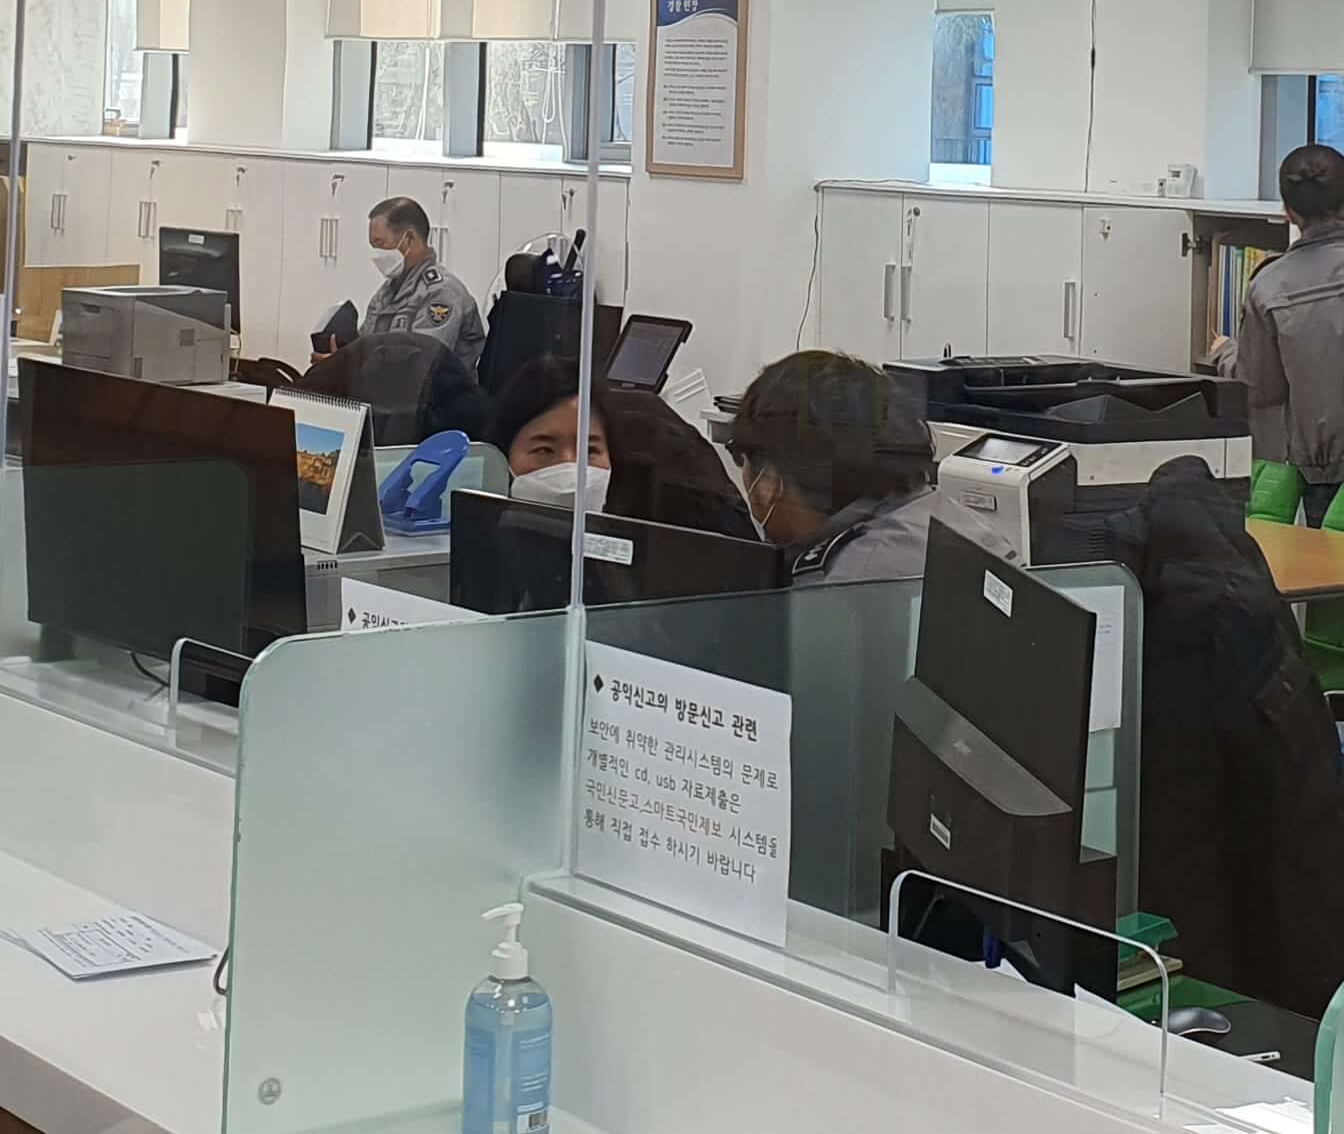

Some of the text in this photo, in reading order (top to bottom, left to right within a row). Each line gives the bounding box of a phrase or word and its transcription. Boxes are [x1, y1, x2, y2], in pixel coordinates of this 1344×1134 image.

[610, 679, 757, 742] 공익신고의 방문신고 관련
[587, 748, 629, 778] 개별적인
[656, 774, 676, 791] usb
[681, 778, 742, 815] 자료제출은
[588, 718, 778, 790] 보안에 취약한 관리시스템의 문제로
[584, 808, 755, 884] 통해 직접 접수 하시기 바랍니다
[729, 826, 777, 859] 시스템을
